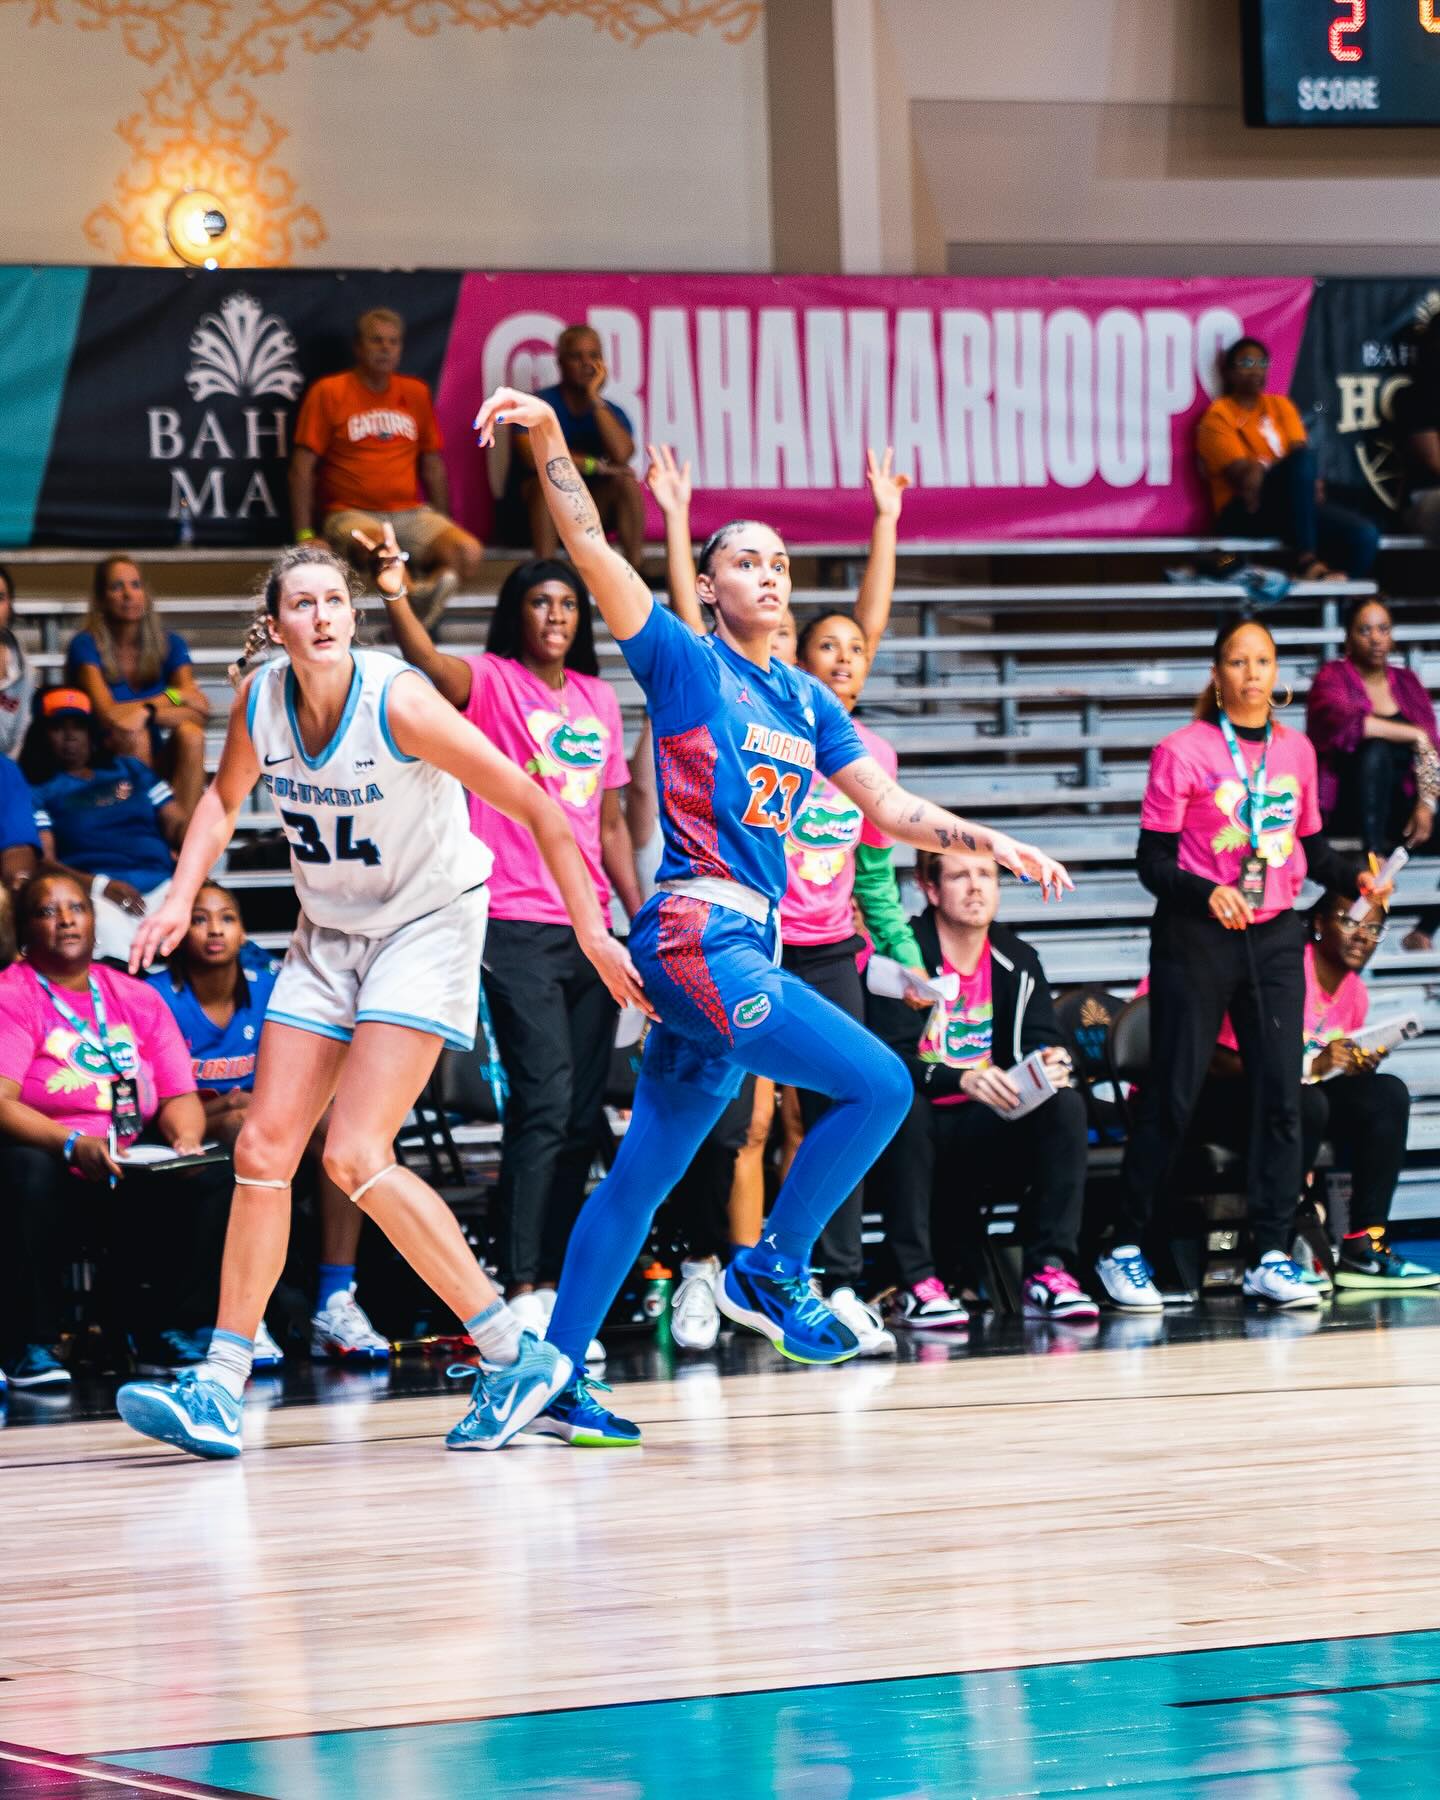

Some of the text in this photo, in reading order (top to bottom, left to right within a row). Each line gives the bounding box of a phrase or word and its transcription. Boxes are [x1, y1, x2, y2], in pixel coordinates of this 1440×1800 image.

[1297, 76, 1380, 110] SCORE
[1361, 340, 1417, 367] BAH
[147, 407, 289, 459] BAH
[167, 466, 279, 519] MA
[740, 722, 816, 771] FLORID
[260, 773, 384, 807] COLUMBIA
[740, 763, 802, 836] 23
[280, 808, 382, 866] 34
